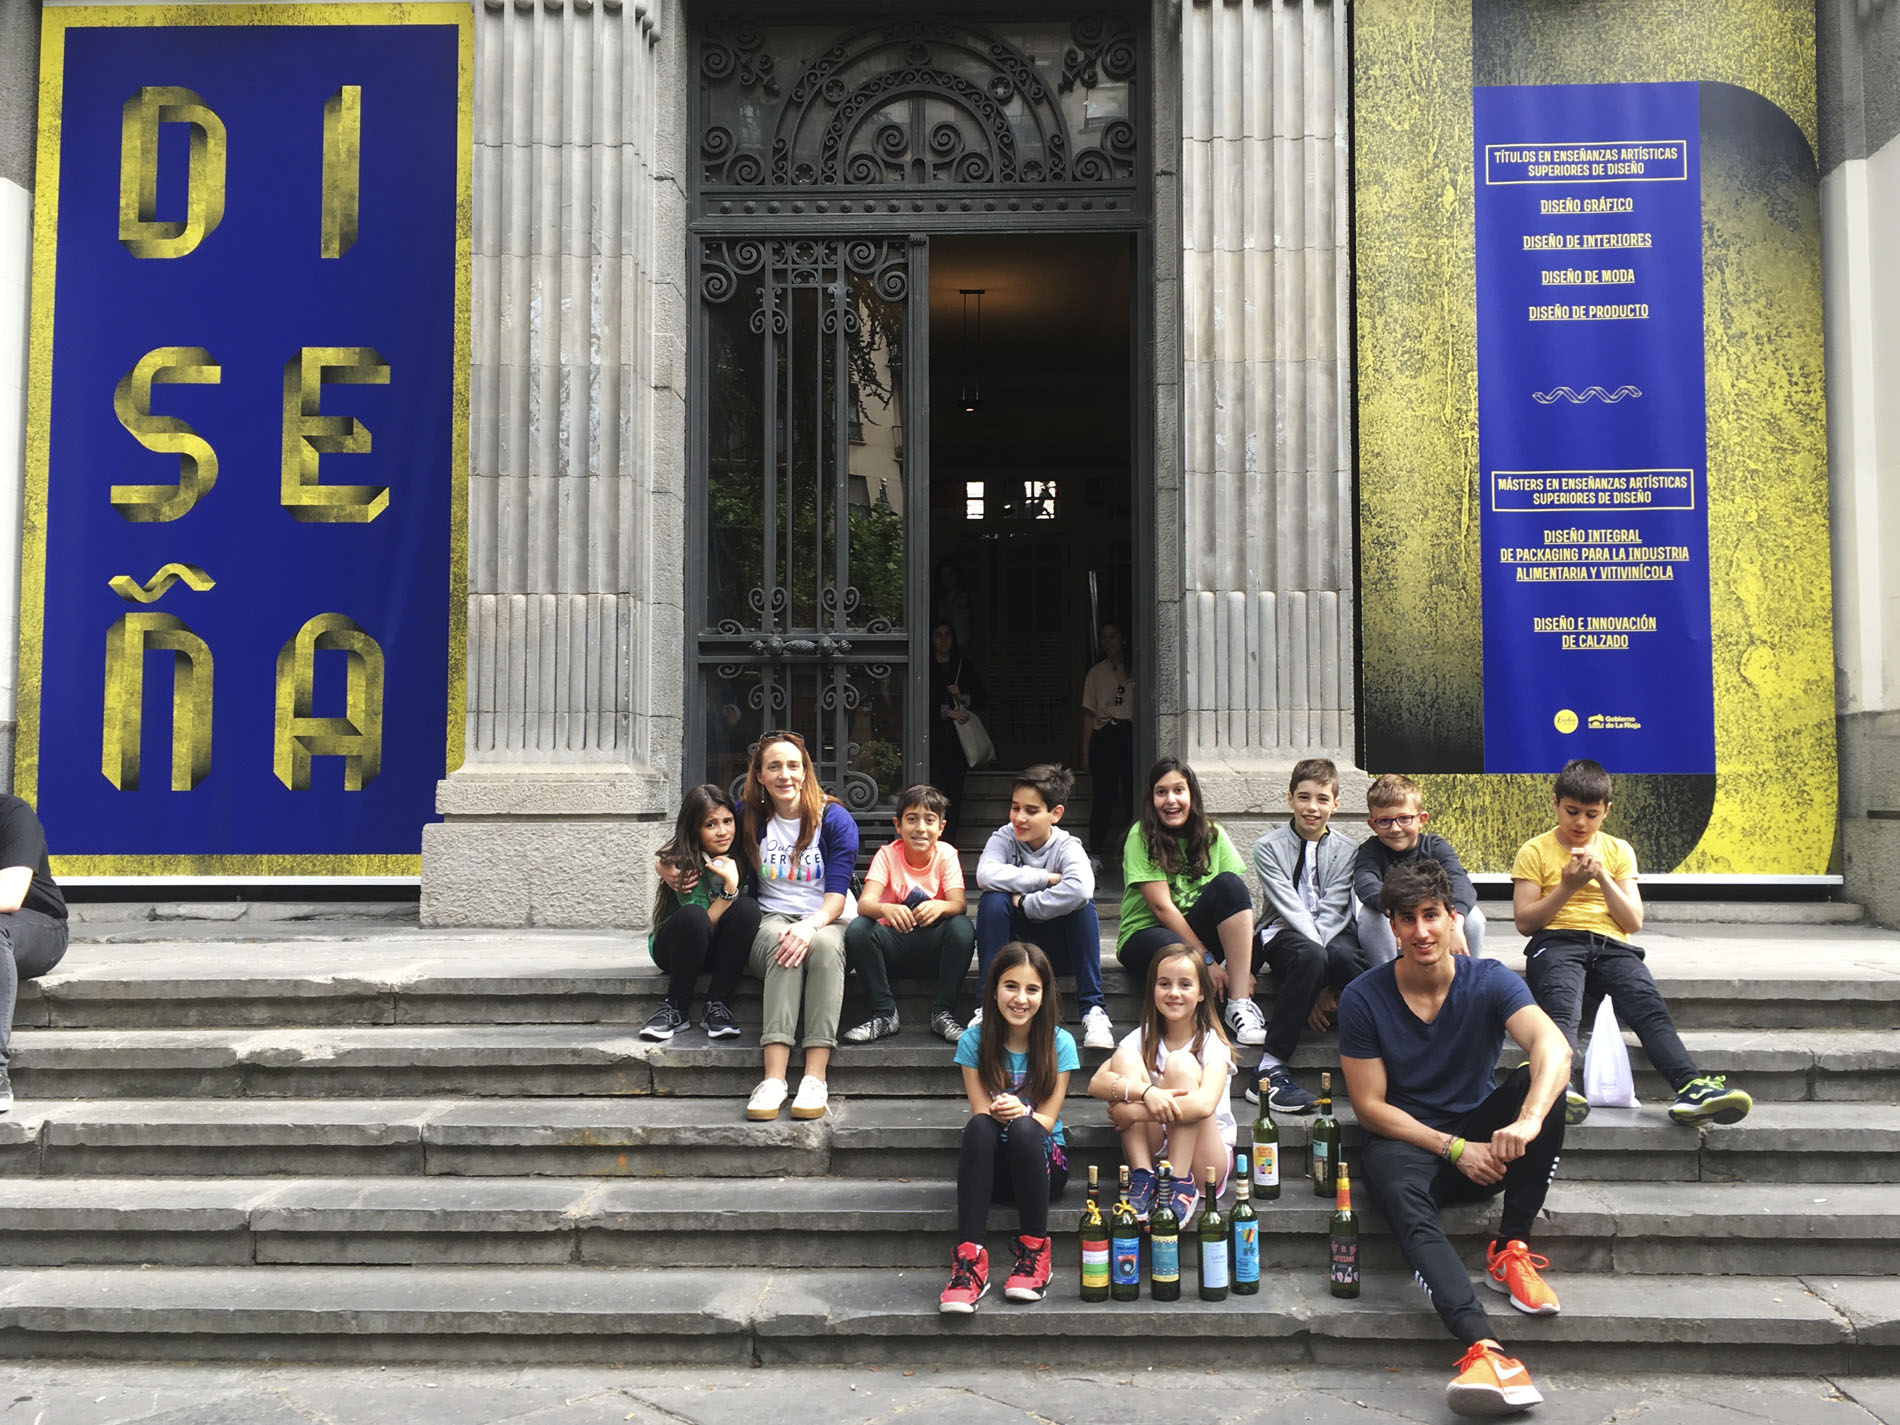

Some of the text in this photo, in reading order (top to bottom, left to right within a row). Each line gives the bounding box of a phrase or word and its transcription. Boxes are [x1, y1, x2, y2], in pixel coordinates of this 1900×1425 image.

[1494, 147, 1678, 163] TÍTULOS EN ENSEÑANZAS ARTÍSTICAS
[1528, 161, 1644, 177] SUPERIORES DE DISEÑO
[1541, 196, 1633, 212] DISEÑO GRÁFICO
[1523, 234, 1652, 248] DISEÑO DE INTERIORES
[1541, 269, 1635, 283] DISEÑO DE MODA
[1529, 304, 1649, 319] DISEÑO DE PRODUCTO
[1498, 474, 1687, 490] MÁSTERS EN ENSEÑANZAS ARTÍSTICAS
[1533, 489, 1652, 504] SUPERIORES DE DISEÑO
[1544, 528, 1642, 543] DISEÑO INTEGRAL
[1501, 547, 1689, 561] DE PACKAGING PARA LA INDUSTRIA
[1516, 564, 1673, 580] ALIMENTARIA Y VITIVINÍCOLA
[1534, 614, 1656, 631] DISEÑO E INNOVACIÓN
[1562, 635, 1629, 648] DE CALZADO
[1624, 721, 1642, 730] Rioja
[767, 839, 798, 852] Out
